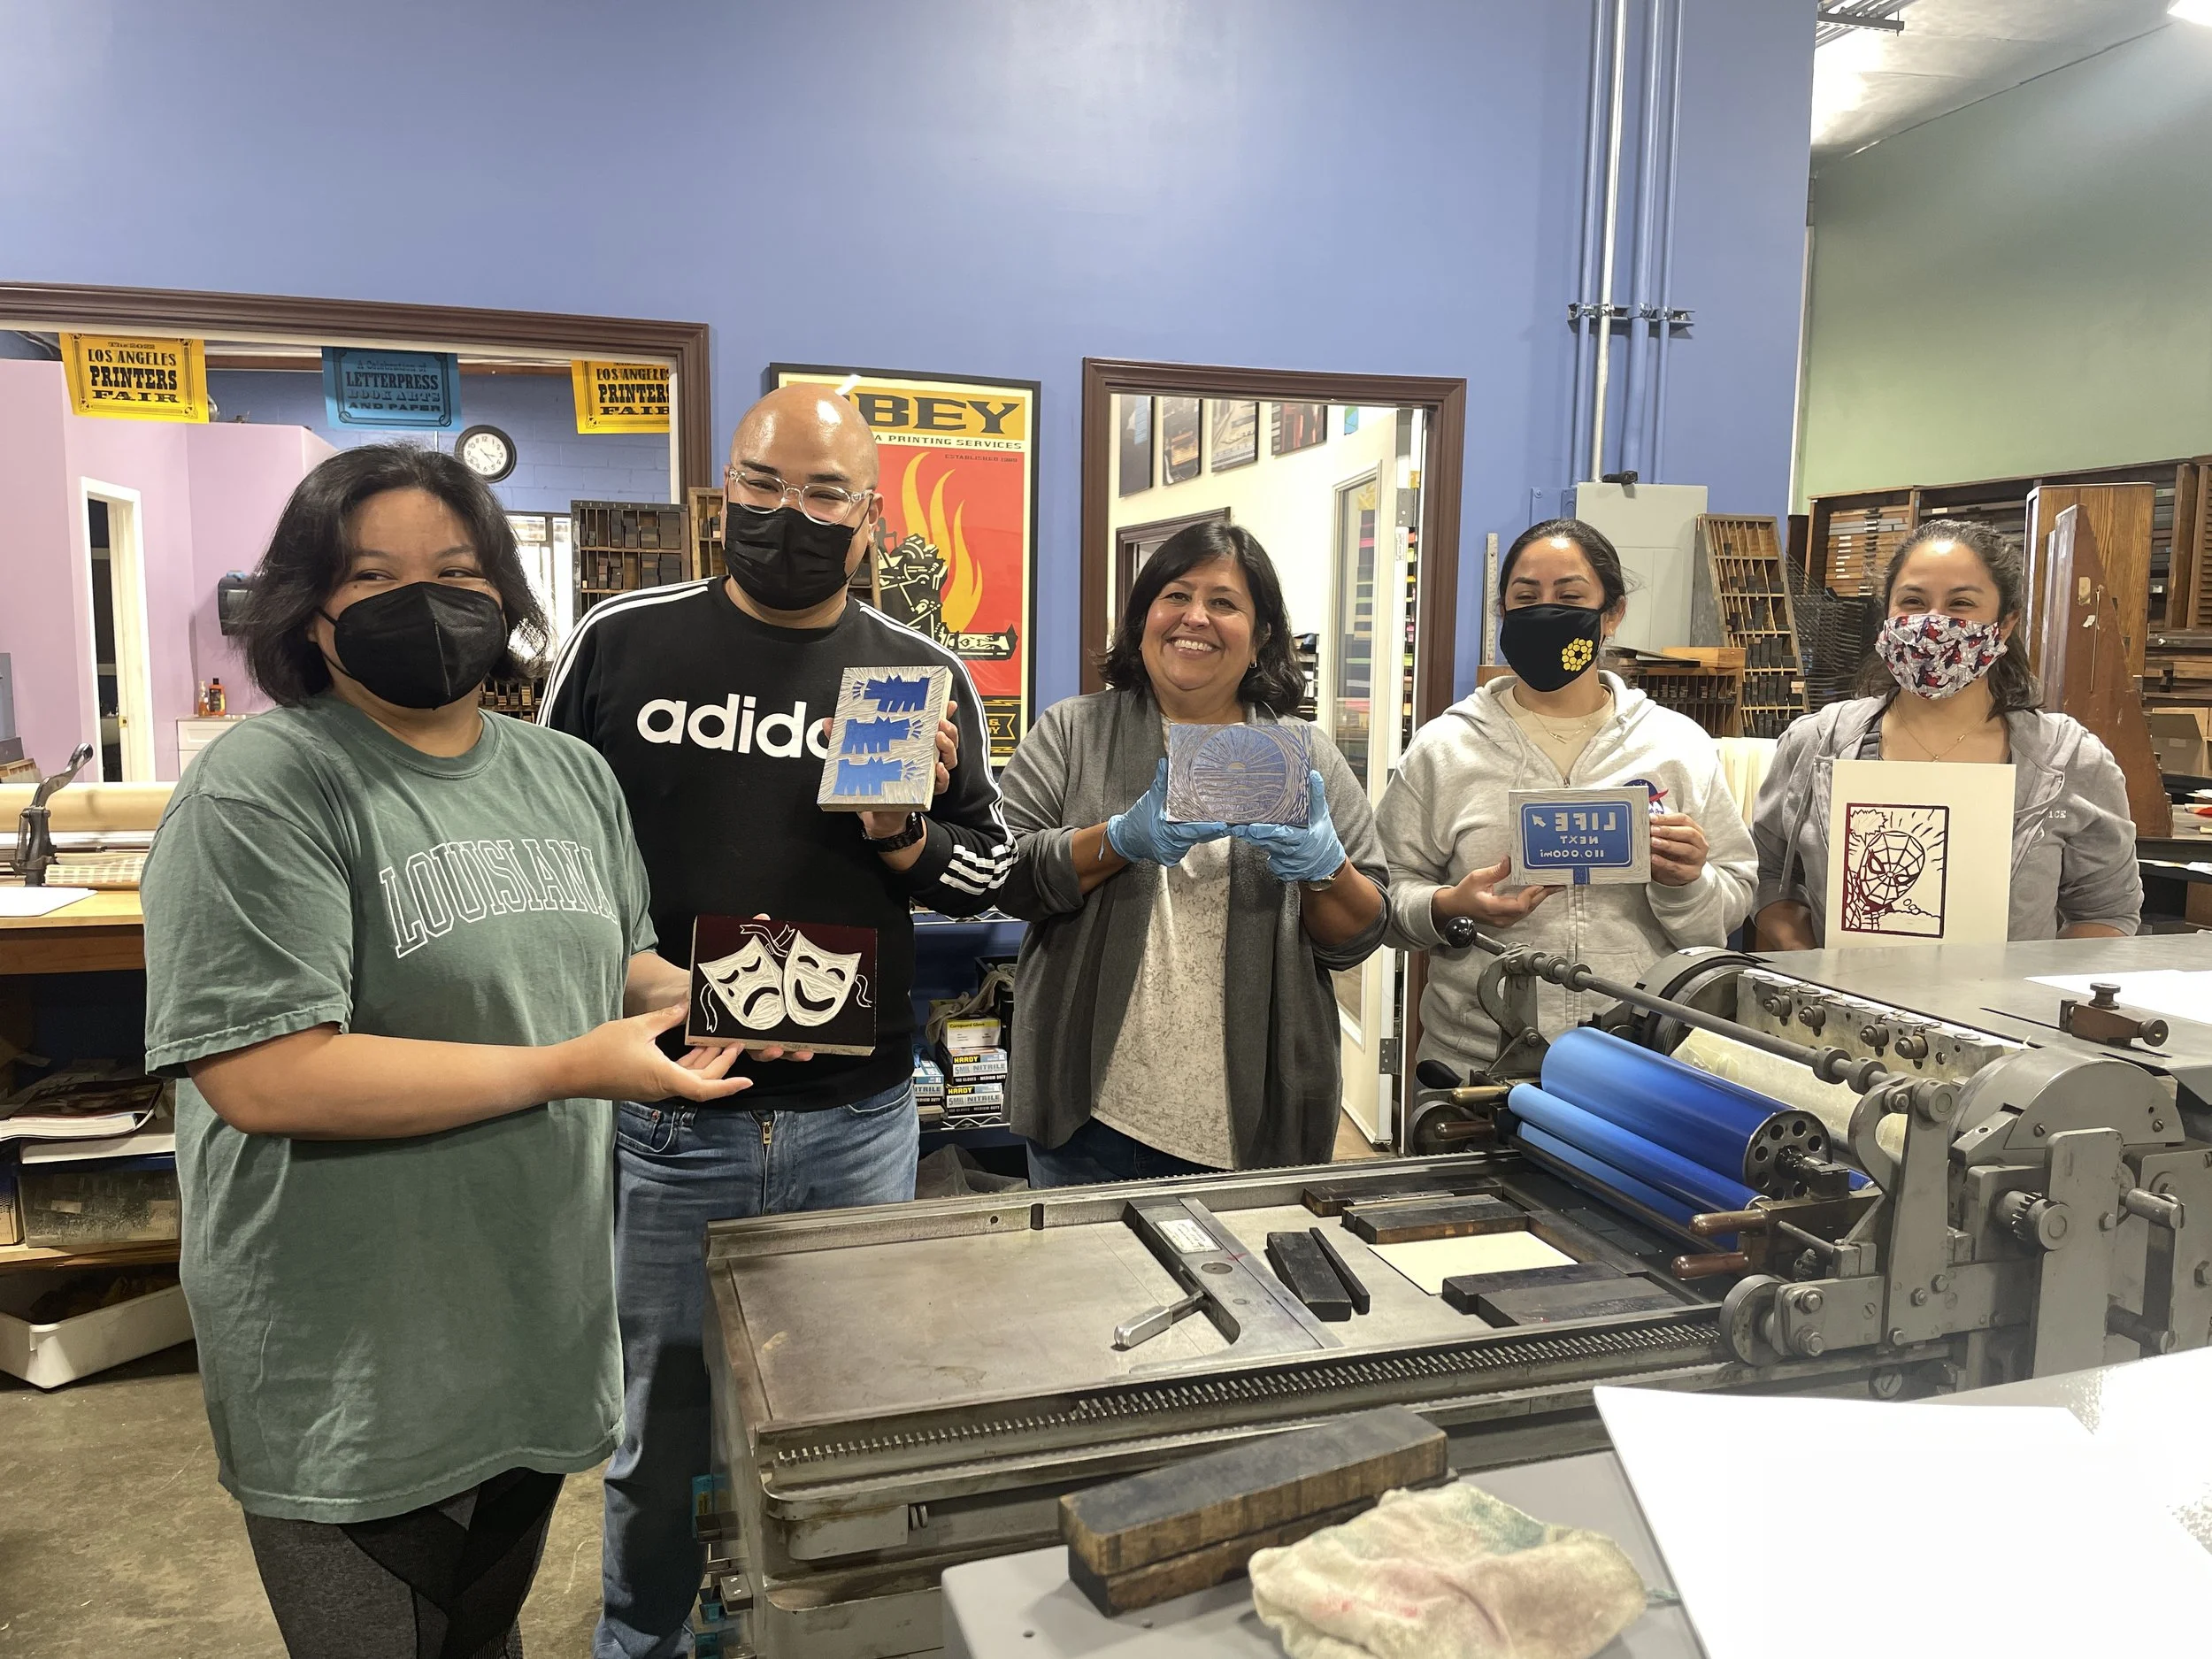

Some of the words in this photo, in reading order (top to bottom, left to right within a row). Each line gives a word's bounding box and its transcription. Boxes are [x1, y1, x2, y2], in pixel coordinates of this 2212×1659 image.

[88, 349, 112, 363] LOS
[118, 350, 177, 366] ANGELES
[89, 365, 178, 390] PRINTERS
[346, 371, 439, 389] LETTERPRESS
[596, 368, 618, 380] LOS
[92, 389, 180, 403] FAIR
[347, 389, 392, 401] BOOK
[396, 390, 441, 403] ARTS
[842, 392, 1020, 434] BEY
[888, 434, 952, 446] PRINTING
[956, 439, 1022, 449] SERVICES
[379, 839, 618, 958] LOUISIANA
